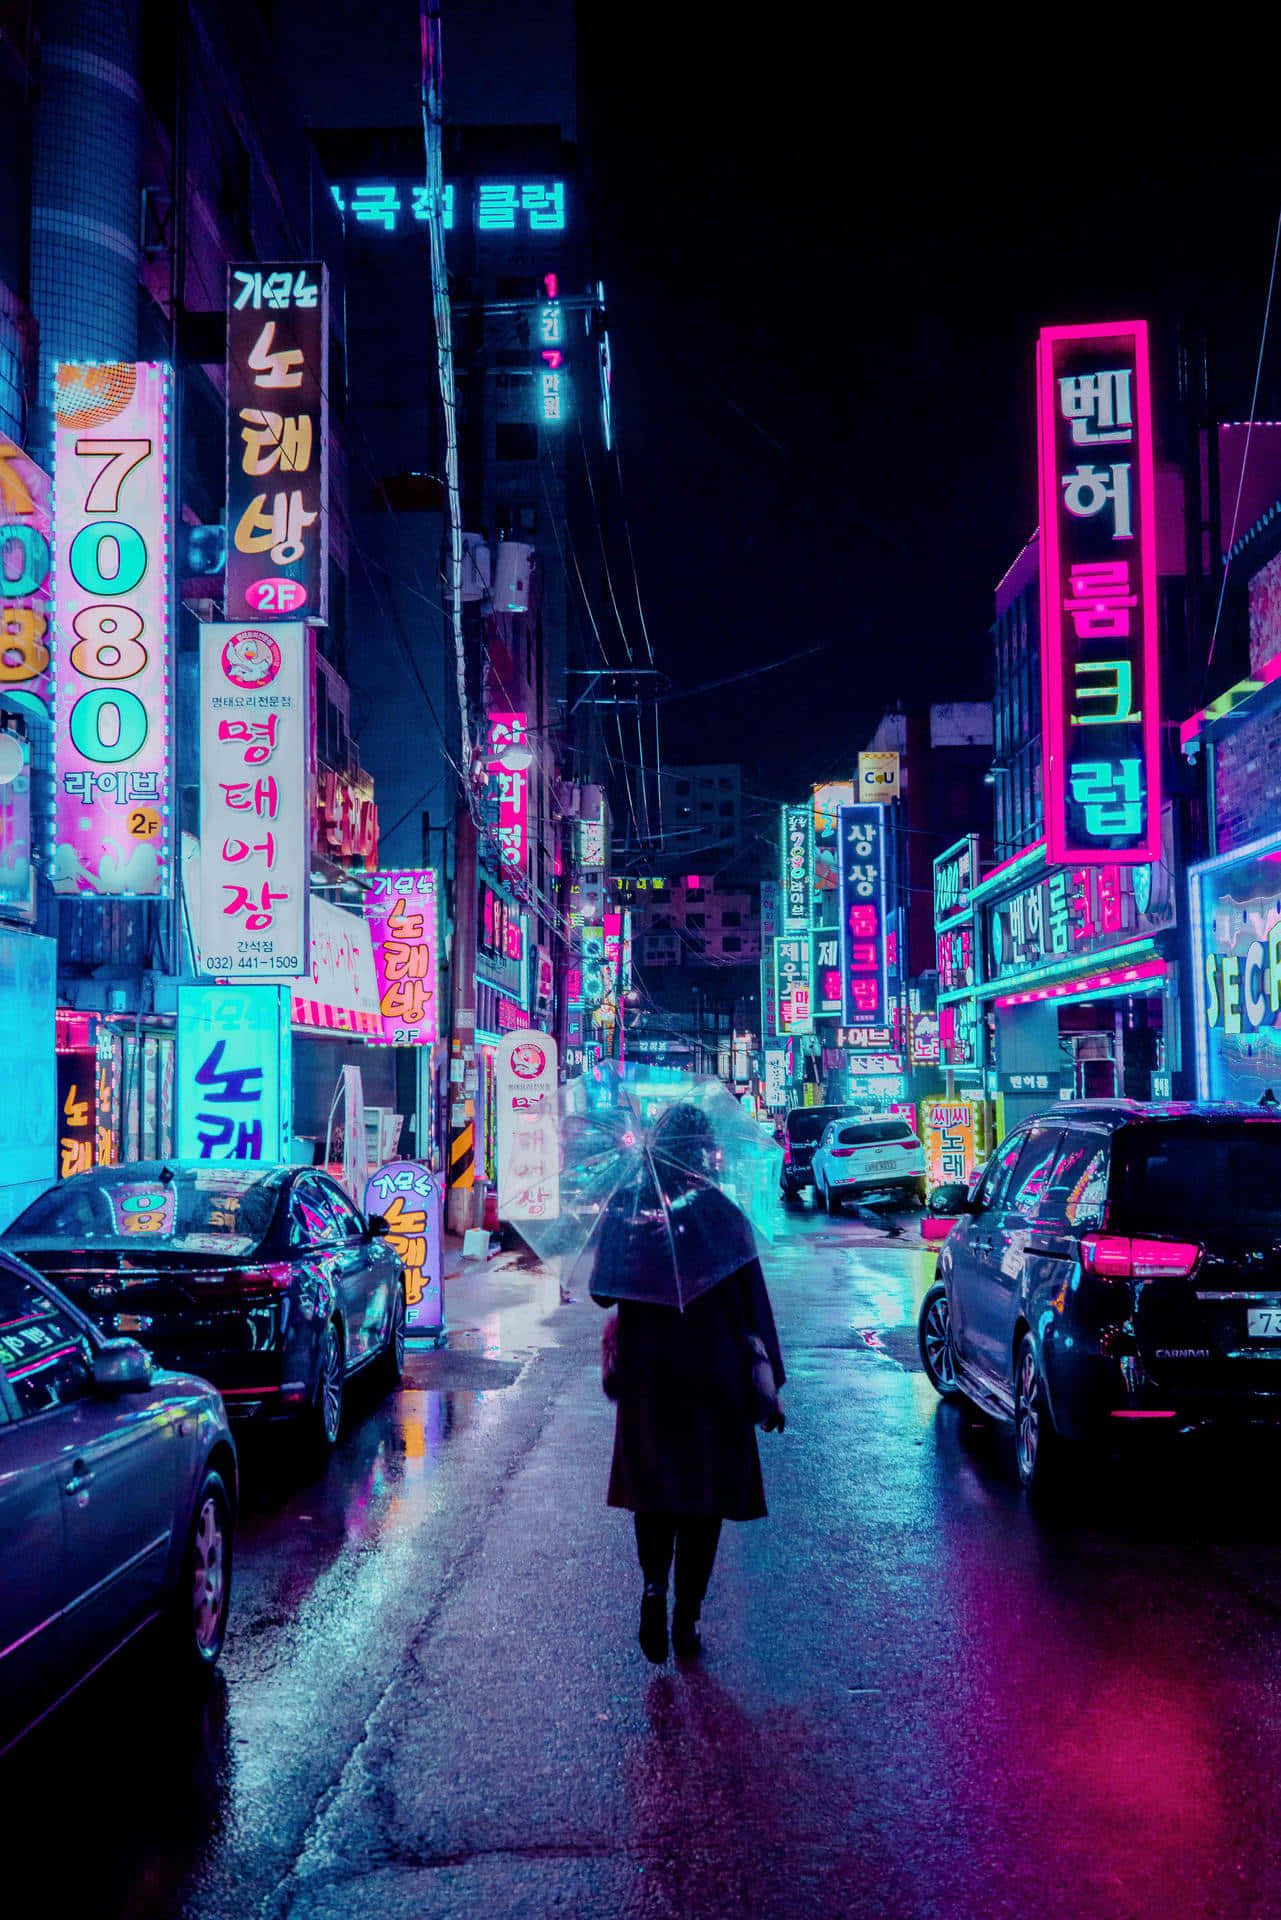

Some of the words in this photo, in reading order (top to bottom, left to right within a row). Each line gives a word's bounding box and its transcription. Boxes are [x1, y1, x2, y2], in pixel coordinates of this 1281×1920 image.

[330, 184, 453, 230] 국적
[479, 183, 565, 229] 클럽
[233, 269, 318, 311] 기모노
[234, 321, 317, 565] 노래방
[69, 437, 153, 764] 7080
[257, 583, 296, 611] 2F
[64, 771, 160, 805] 라이브
[864, 771, 895, 784] CU
[131, 812, 159, 836] 2F
[217, 713, 289, 931] 명태어장
[373, 875, 435, 896] 기모노
[206, 955, 233, 970] 032)
[238, 955, 299, 969] 441-1509
[236, 940, 274, 953] 간석점
[380, 897, 434, 1025] 노래방
[394, 1028, 421, 1043] 2F
[940, 1126, 966, 1184] 노래
